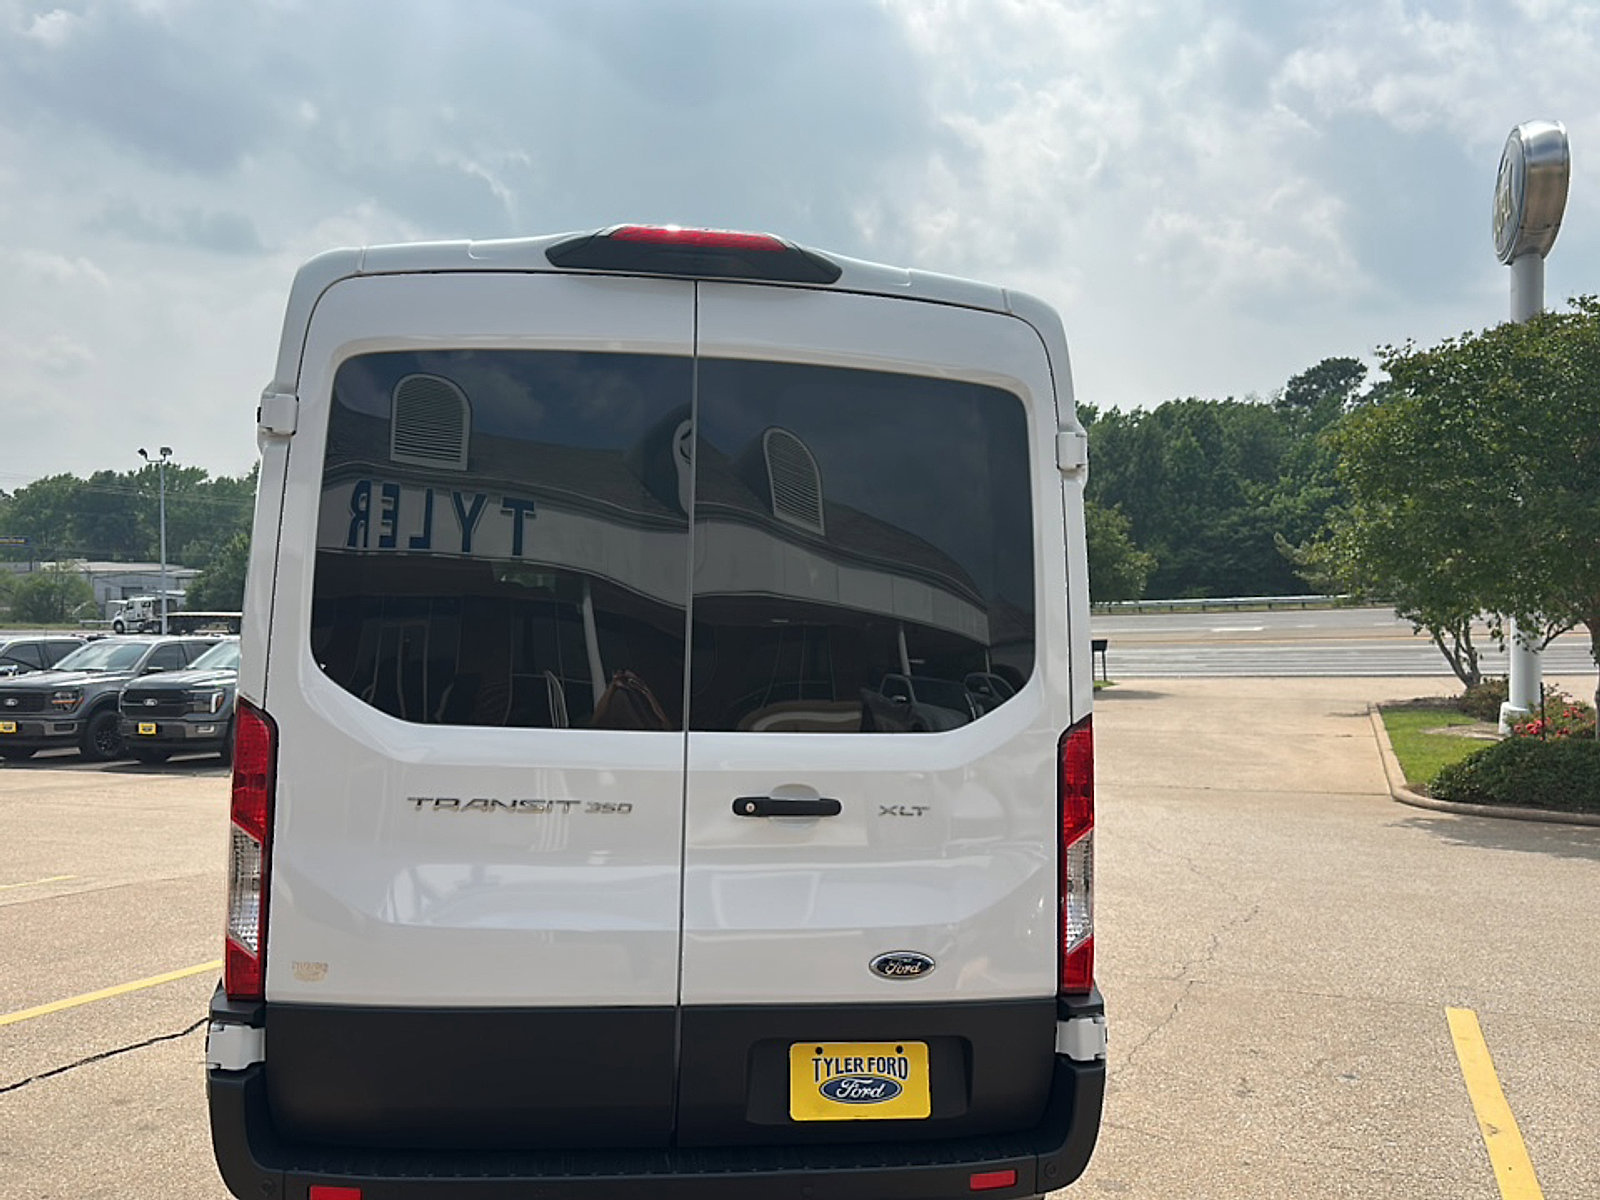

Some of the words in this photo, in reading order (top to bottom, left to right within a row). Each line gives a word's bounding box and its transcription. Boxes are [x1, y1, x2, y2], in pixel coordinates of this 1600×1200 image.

[407, 796, 581, 814] TRANSIT
[585, 800, 633, 815] 350
[878, 804, 930, 817] XLT
[885, 958, 922, 976] Ford
[811, 1056, 865, 1083] TYLER
[866, 1056, 909, 1081] FORD
[836, 1078, 887, 1099] Ford
